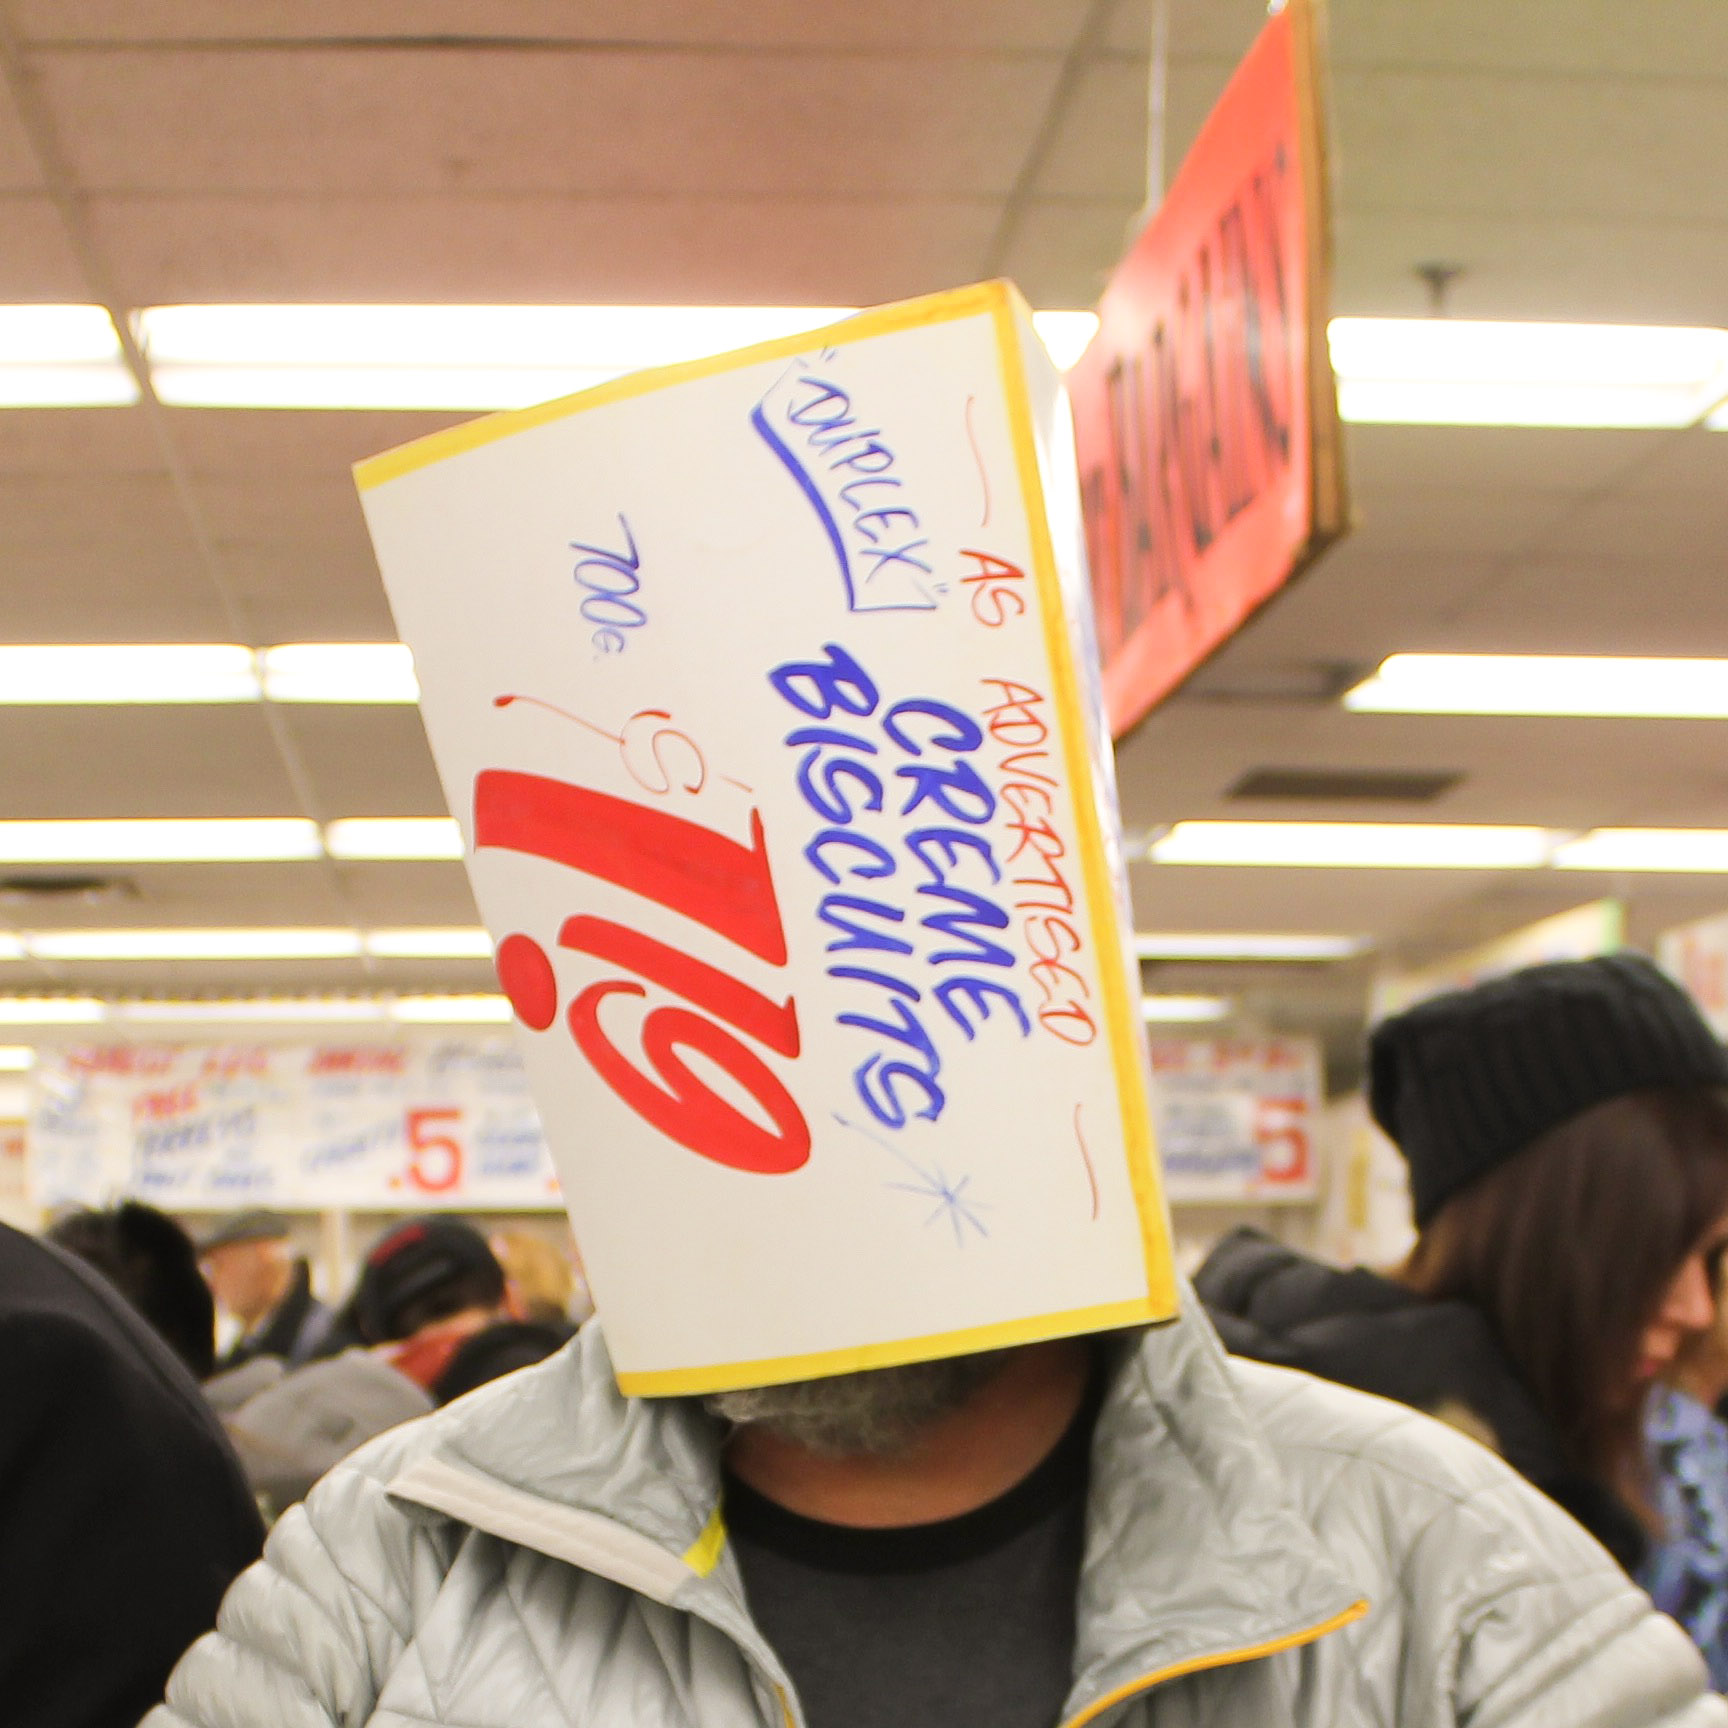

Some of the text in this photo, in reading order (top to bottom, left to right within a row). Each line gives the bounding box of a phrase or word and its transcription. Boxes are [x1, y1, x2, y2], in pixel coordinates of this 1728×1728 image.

[767, 641, 948, 1131] BISCUITS
[882, 697, 1031, 1040] CREME
[958, 548, 1098, 1048] AS ADVERTISED
